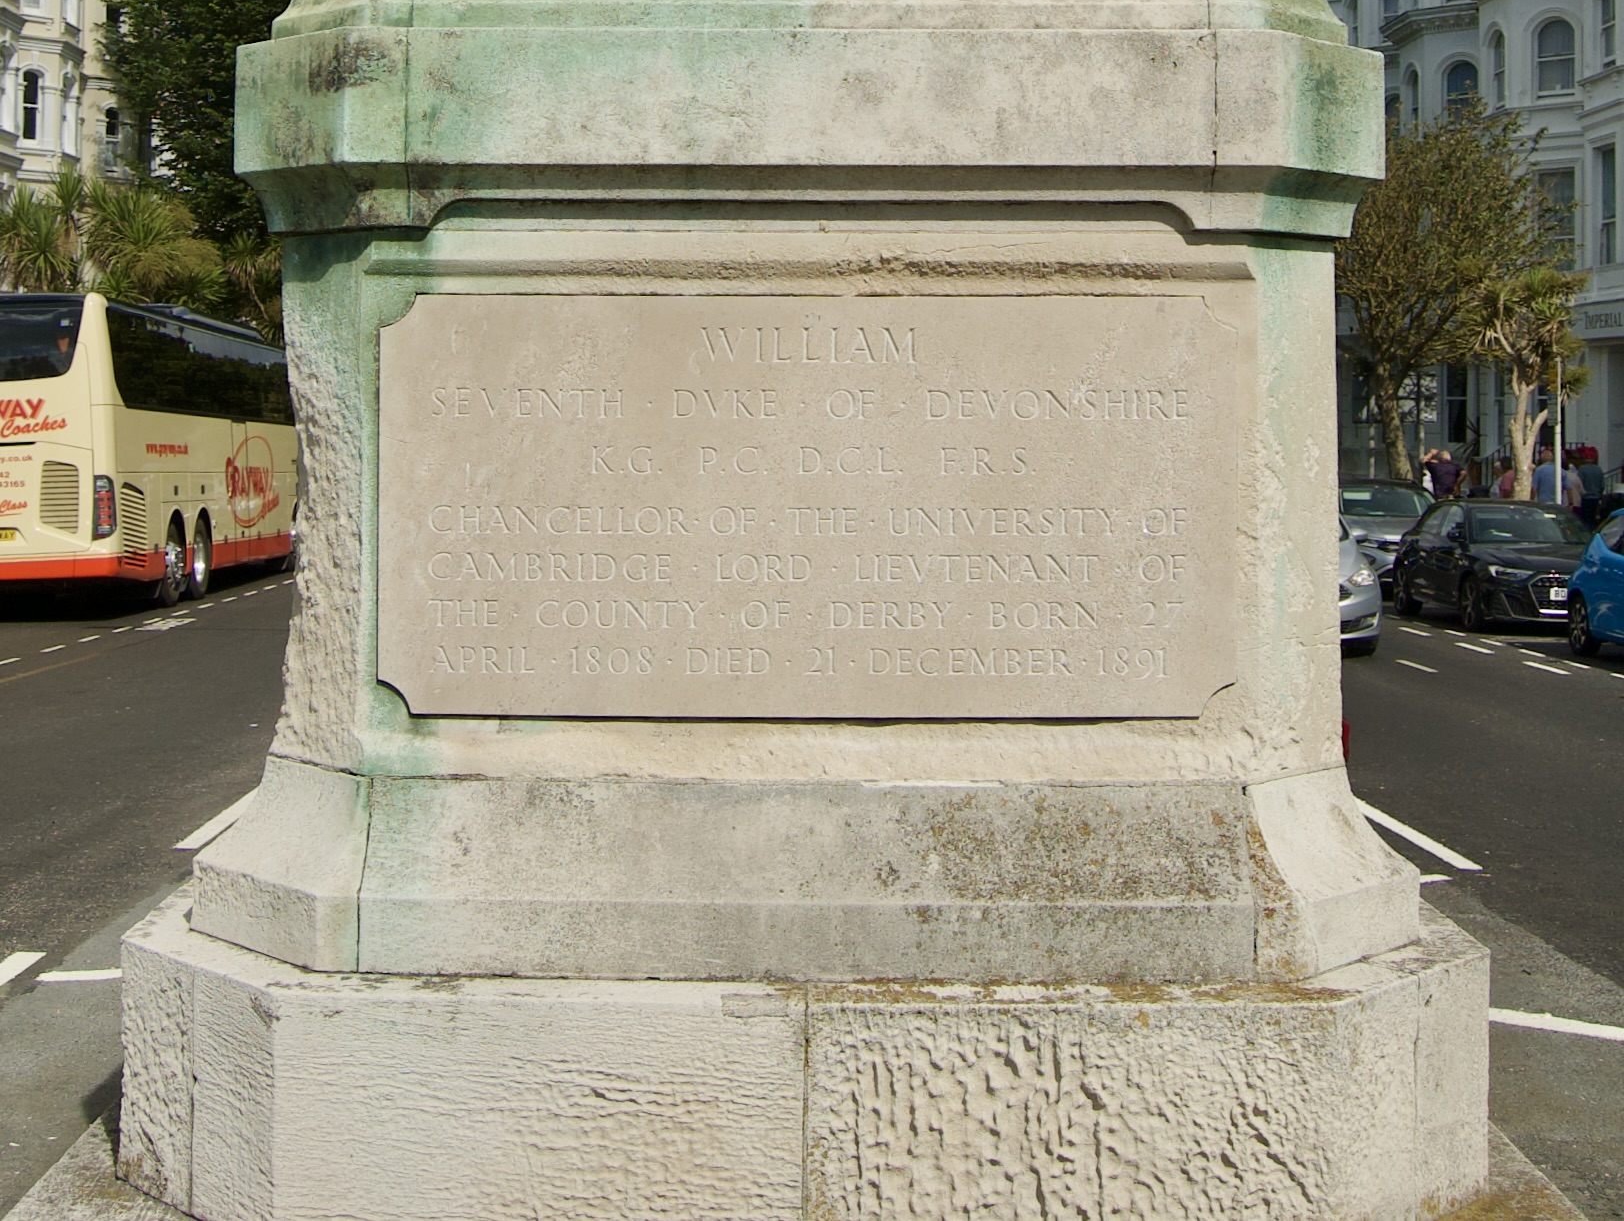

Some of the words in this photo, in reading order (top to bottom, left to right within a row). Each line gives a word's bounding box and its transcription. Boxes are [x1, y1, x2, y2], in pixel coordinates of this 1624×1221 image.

[1584, 311, 1623, 330] IMPERIAL
[700, 326, 919, 364] WILLIAM
[431, 387, 625, 419] SEVENTH
[671, 388, 778, 420] DVKE
[826, 388, 876, 421] OF
[926, 388, 1189, 421] DEVONSHIRE
[1, 415, 68, 438] Coaches
[590, 445, 664, 475] K.G.
[698, 445, 769, 475] P.C.
[797, 446, 904, 476] D.C.L.
[940, 446, 1037, 476] F.R.S.
[428, 504, 694, 536] CHANCELLOR
[709, 505, 757, 536] OF
[785, 506, 858, 537] THE
[888, 507, 1117, 537] UNIVERSITY
[1141, 507, 1188, 537] OF
[427, 551, 672, 582] CAMBRIDGE
[714, 553, 812, 583] LORD
[854, 553, 1101, 584] LIEVTENANT
[1138, 554, 1187, 584] OF
[427, 598, 500, 628] THE
[535, 599, 707, 630] COUNTY
[740, 600, 792, 630] OF
[828, 600, 953, 630] DERBY
[988, 601, 1100, 630] BORN
[1139, 601, 1185, 629] 27
[431, 645, 536, 675] APRIL
[568, 645, 655, 676] 1808
[684, 646, 772, 676] DIED
[803, 647, 837, 676] 21
[868, 647, 1075, 677] DECEMBER
[1098, 646, 1172, 679] 1891
